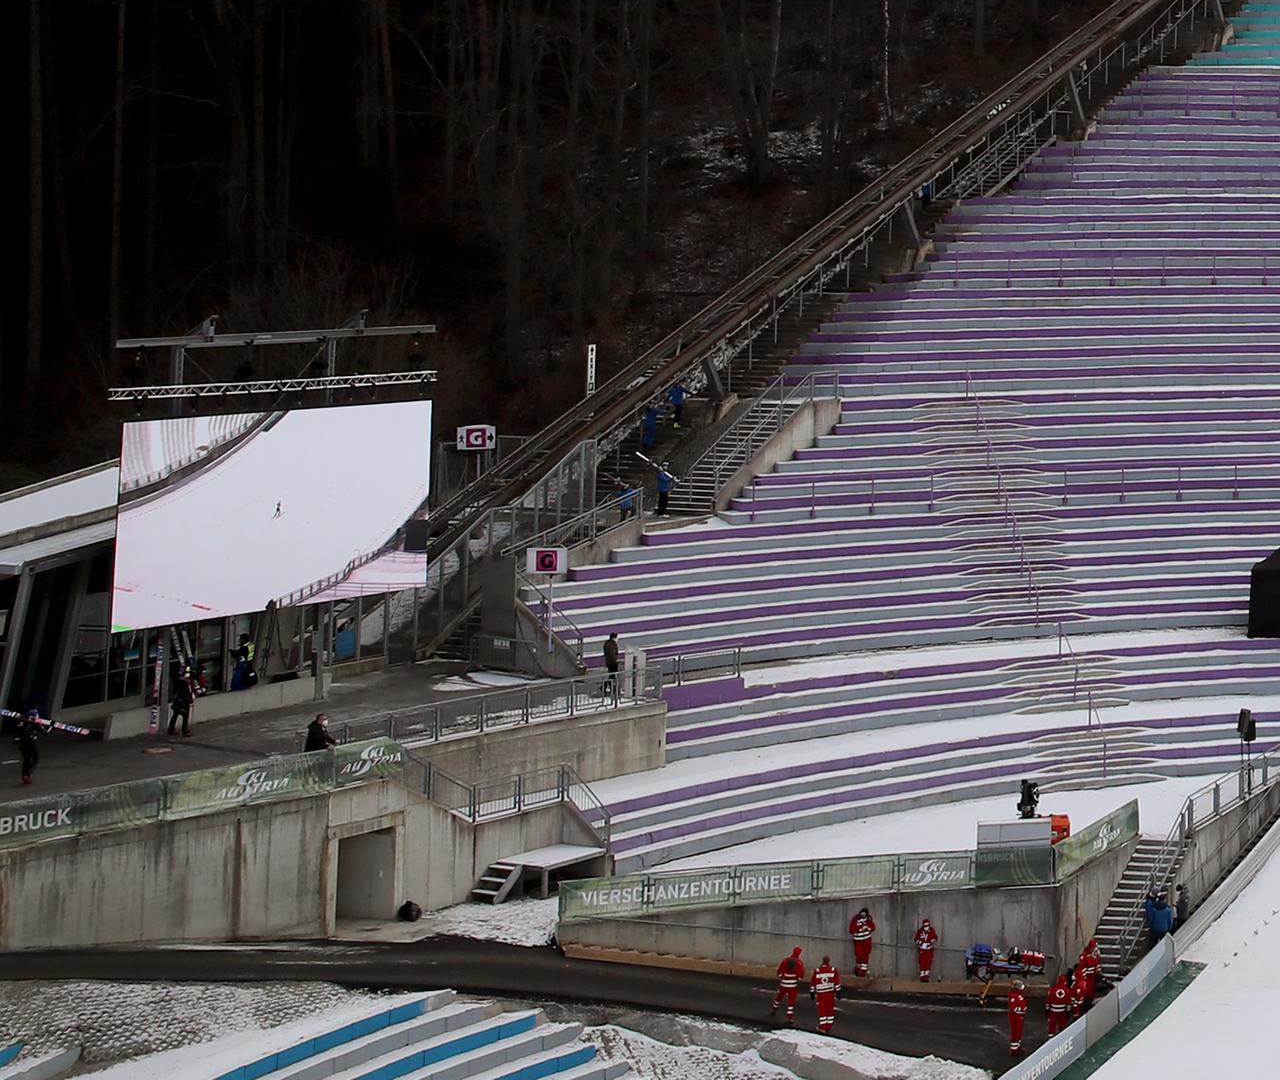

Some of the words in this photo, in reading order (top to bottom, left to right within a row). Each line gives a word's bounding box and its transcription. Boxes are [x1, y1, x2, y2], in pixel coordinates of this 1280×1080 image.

[470, 432, 482, 444] G
[540, 554, 554, 568] G
[340, 752, 402, 777] AUSTRIA
[214, 777, 290, 801] AUSTRIA
[0, 807, 72, 835] BRUCK
[582, 874, 791, 906] VIERSCHANZENTOURNEE
[900, 870, 965, 886] AUSTRIA
